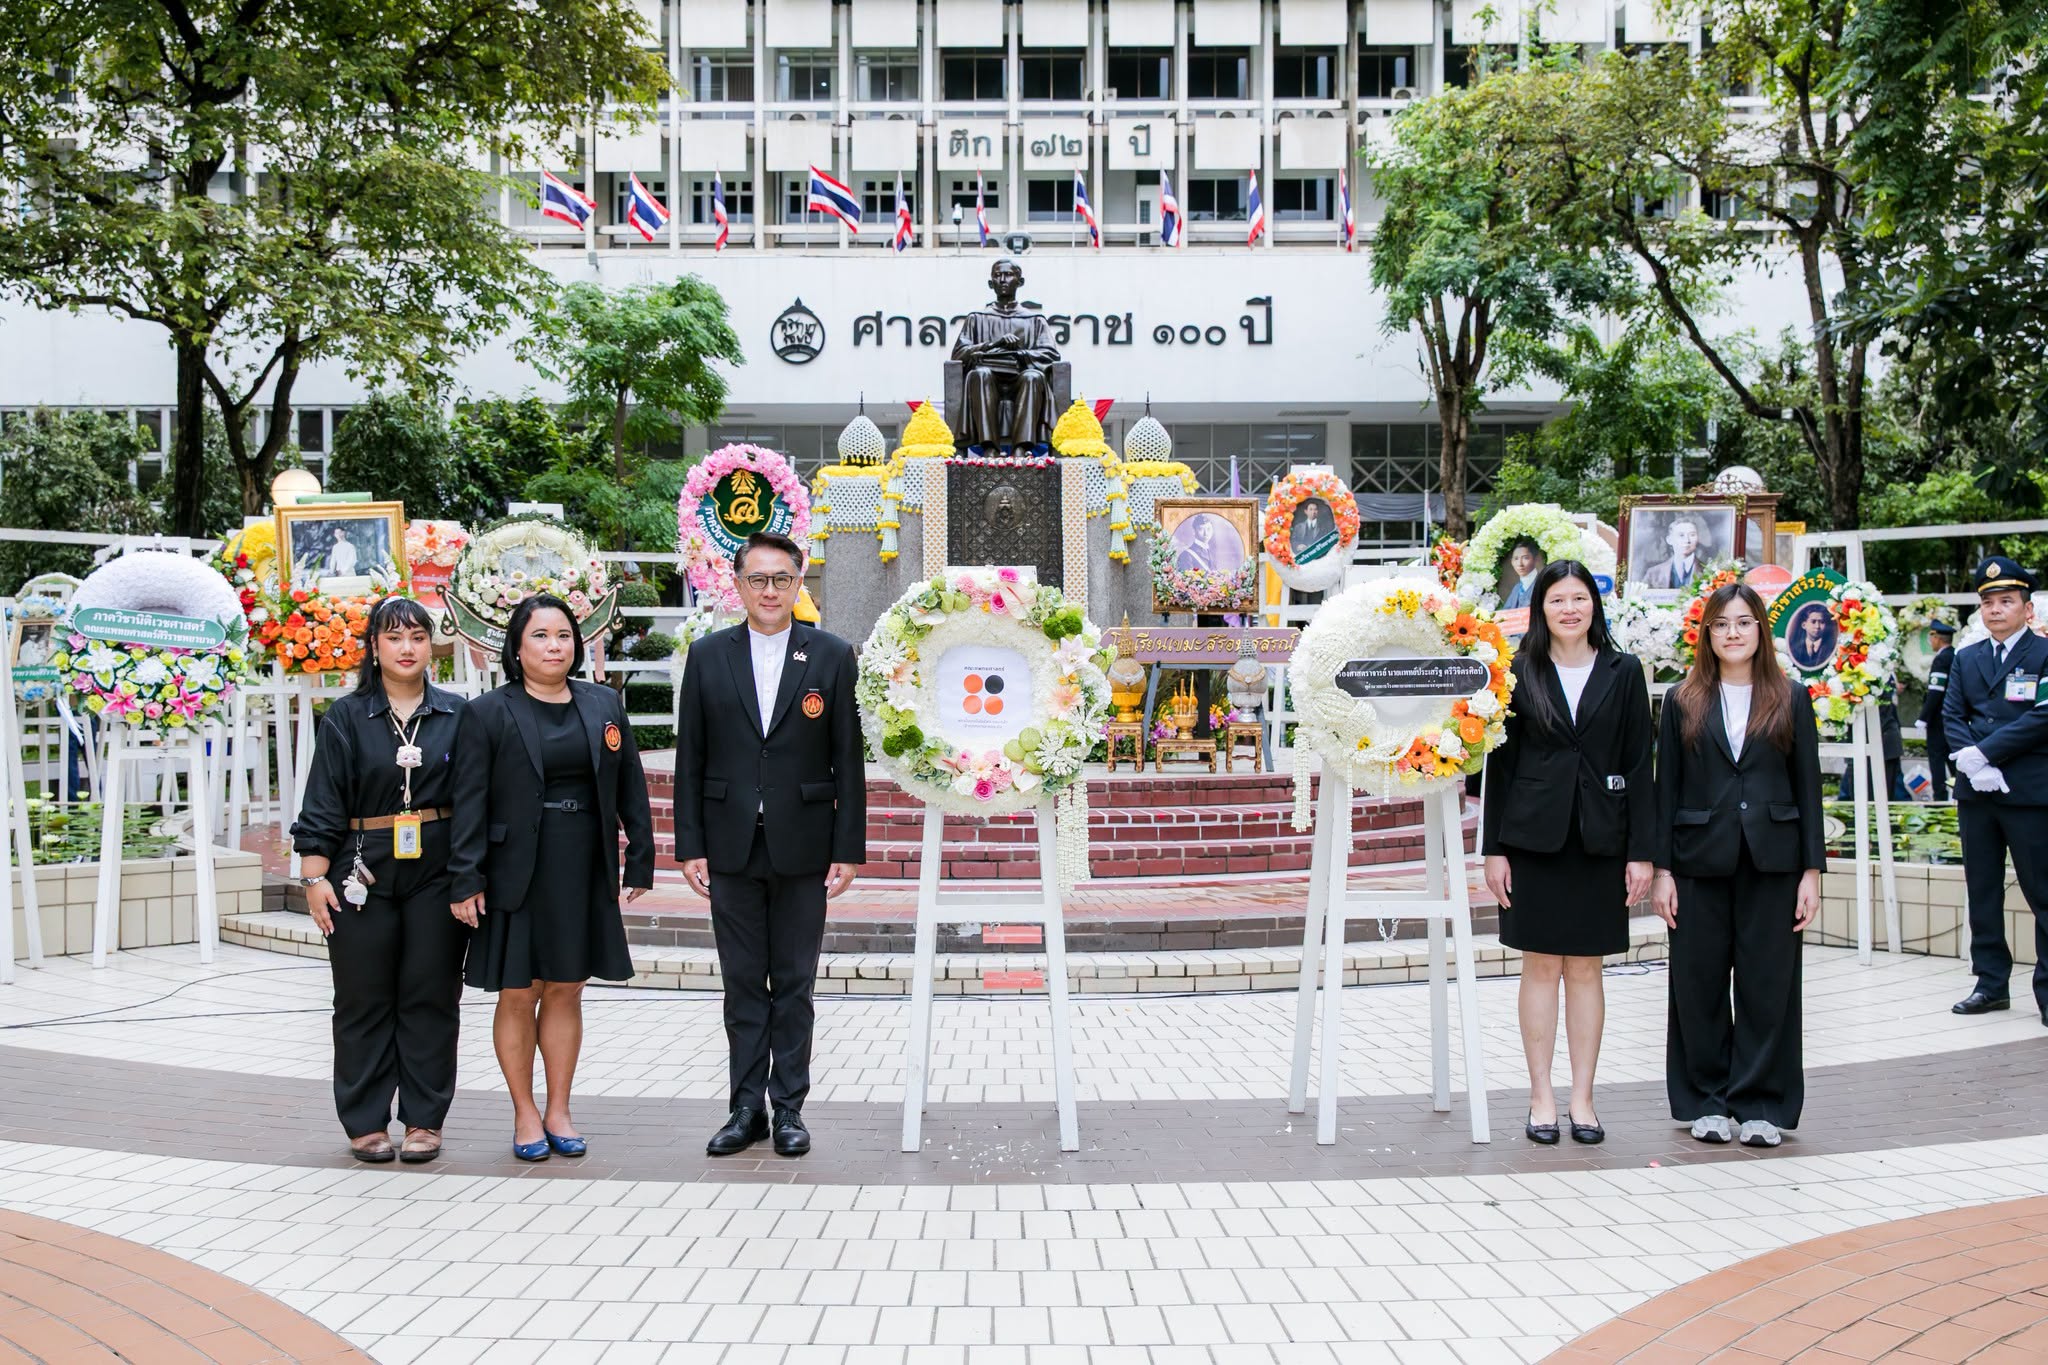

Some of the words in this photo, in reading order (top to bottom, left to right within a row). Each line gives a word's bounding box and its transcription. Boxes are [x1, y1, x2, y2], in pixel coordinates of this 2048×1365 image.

[949, 129, 992, 157] ตึก
[1030, 133, 1083, 157] ๗๒
[1129, 123, 1151, 157] ปี
[1153, 324, 1227, 346] ๑๐๐
[1239, 296, 1273, 345] ปี
[83, 624, 216, 645] คณะแพทยศาสตร์ศิริราชพยาบาล
[92, 611, 206, 632] ภาควิชานิติเวชศาสตร์
